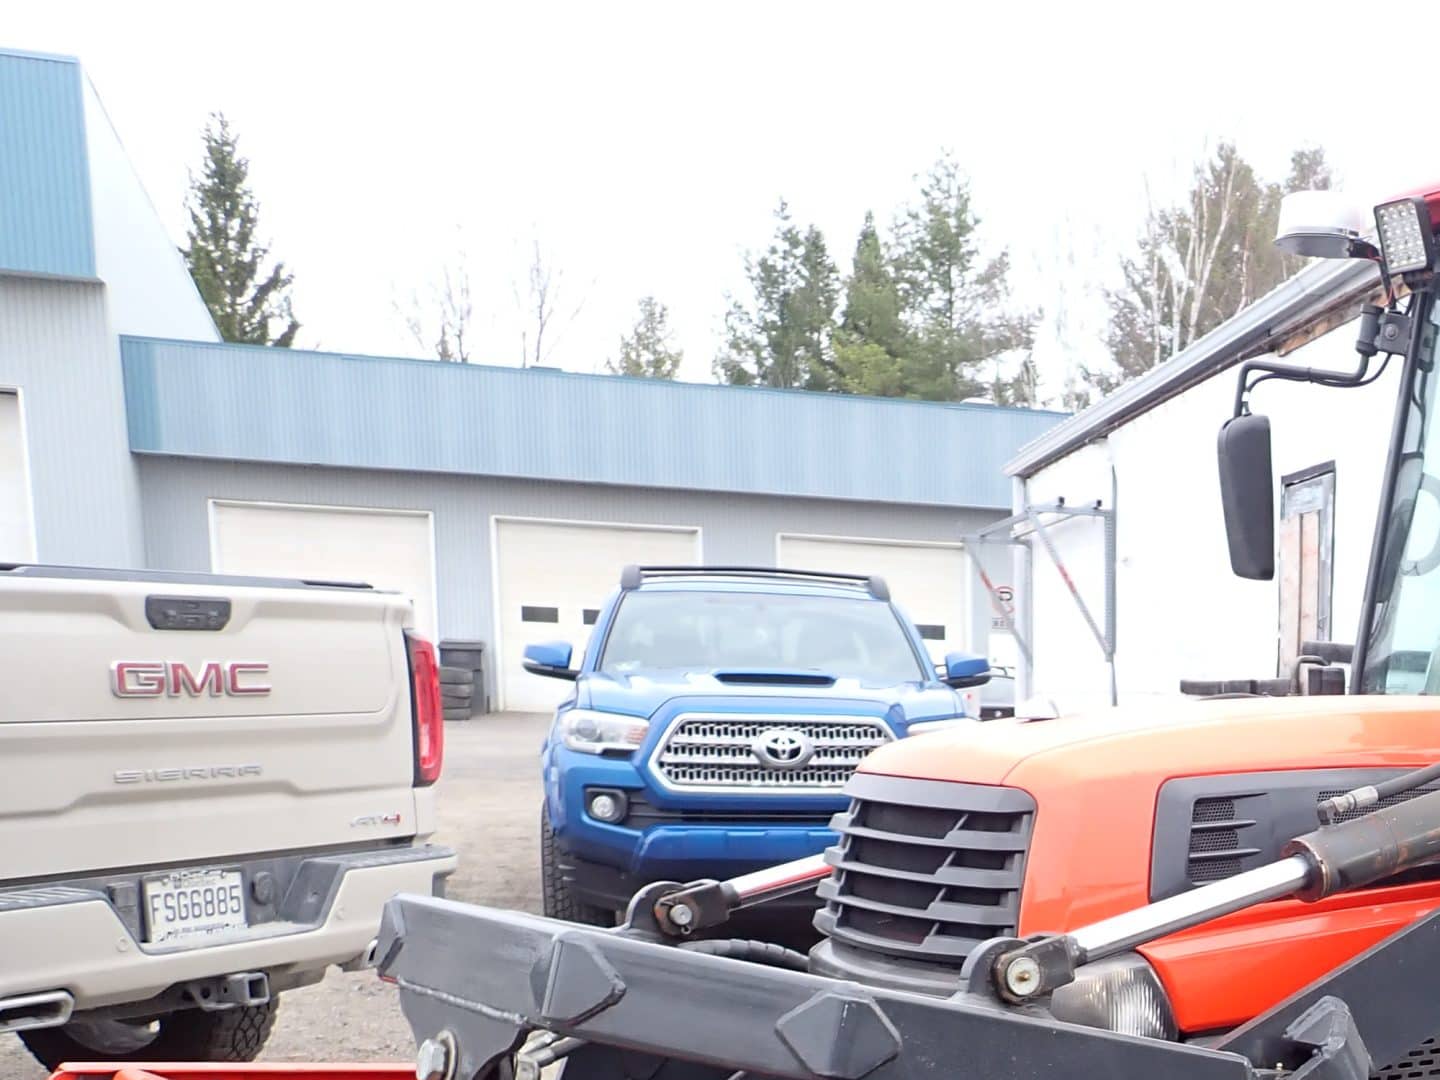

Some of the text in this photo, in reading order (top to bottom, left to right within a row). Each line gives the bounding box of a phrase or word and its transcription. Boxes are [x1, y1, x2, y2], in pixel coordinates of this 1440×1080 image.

[110, 661, 271, 698] GMC
[114, 764, 262, 783] SIERRA
[150, 885, 241, 925] FSG6885
